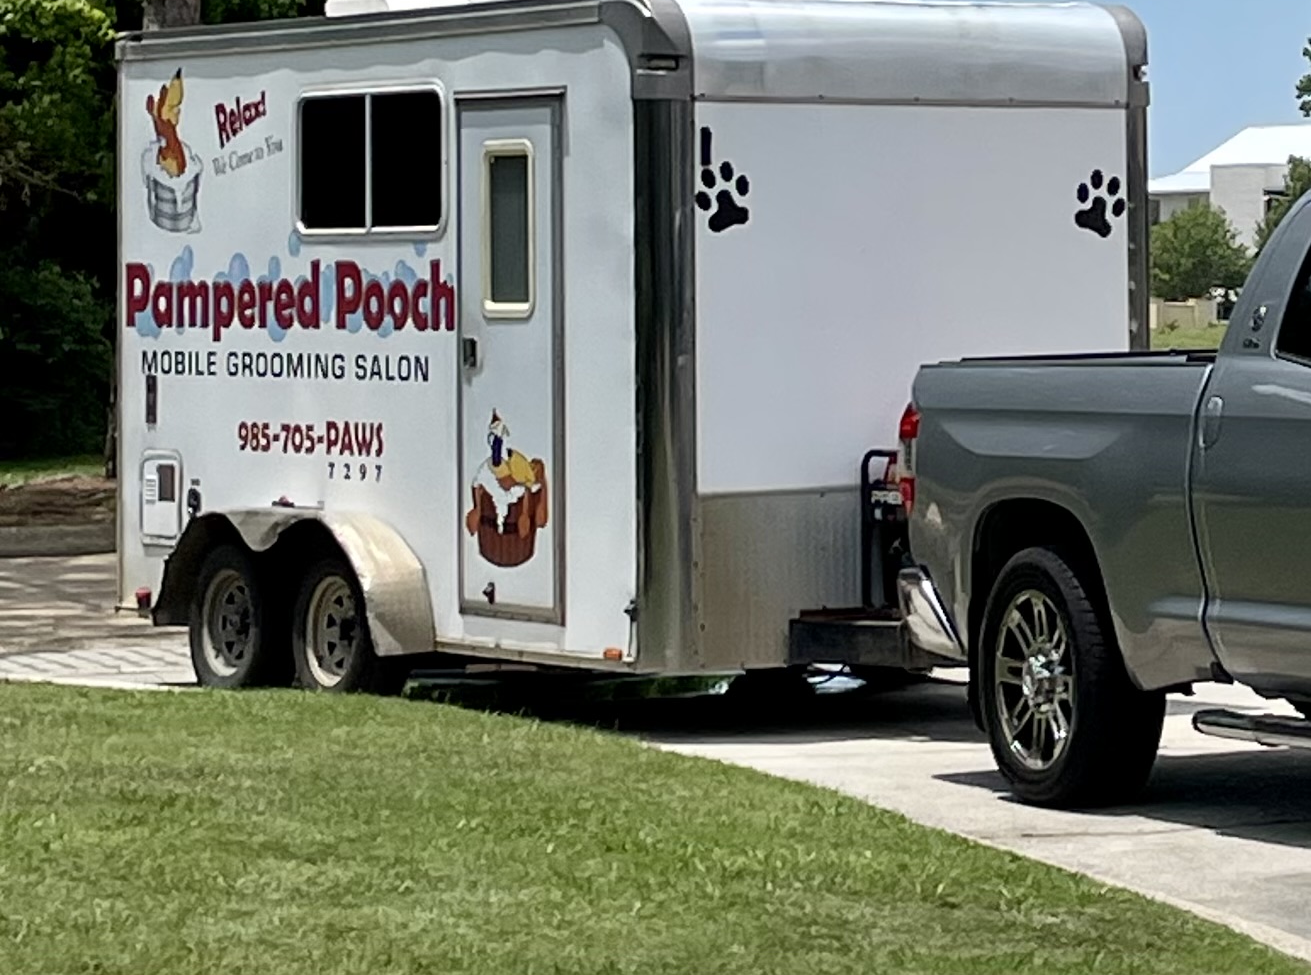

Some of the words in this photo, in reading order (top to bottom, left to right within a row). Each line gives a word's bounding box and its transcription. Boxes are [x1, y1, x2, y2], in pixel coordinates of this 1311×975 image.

[125, 259, 321, 343] Pampered
[335, 258, 456, 332] Pooch
[141, 349, 218, 376] MOBILE
[226, 351, 346, 380] GROOMING
[354, 354, 429, 383] SALON
[238, 420, 384, 458] 985-705-PAWS
